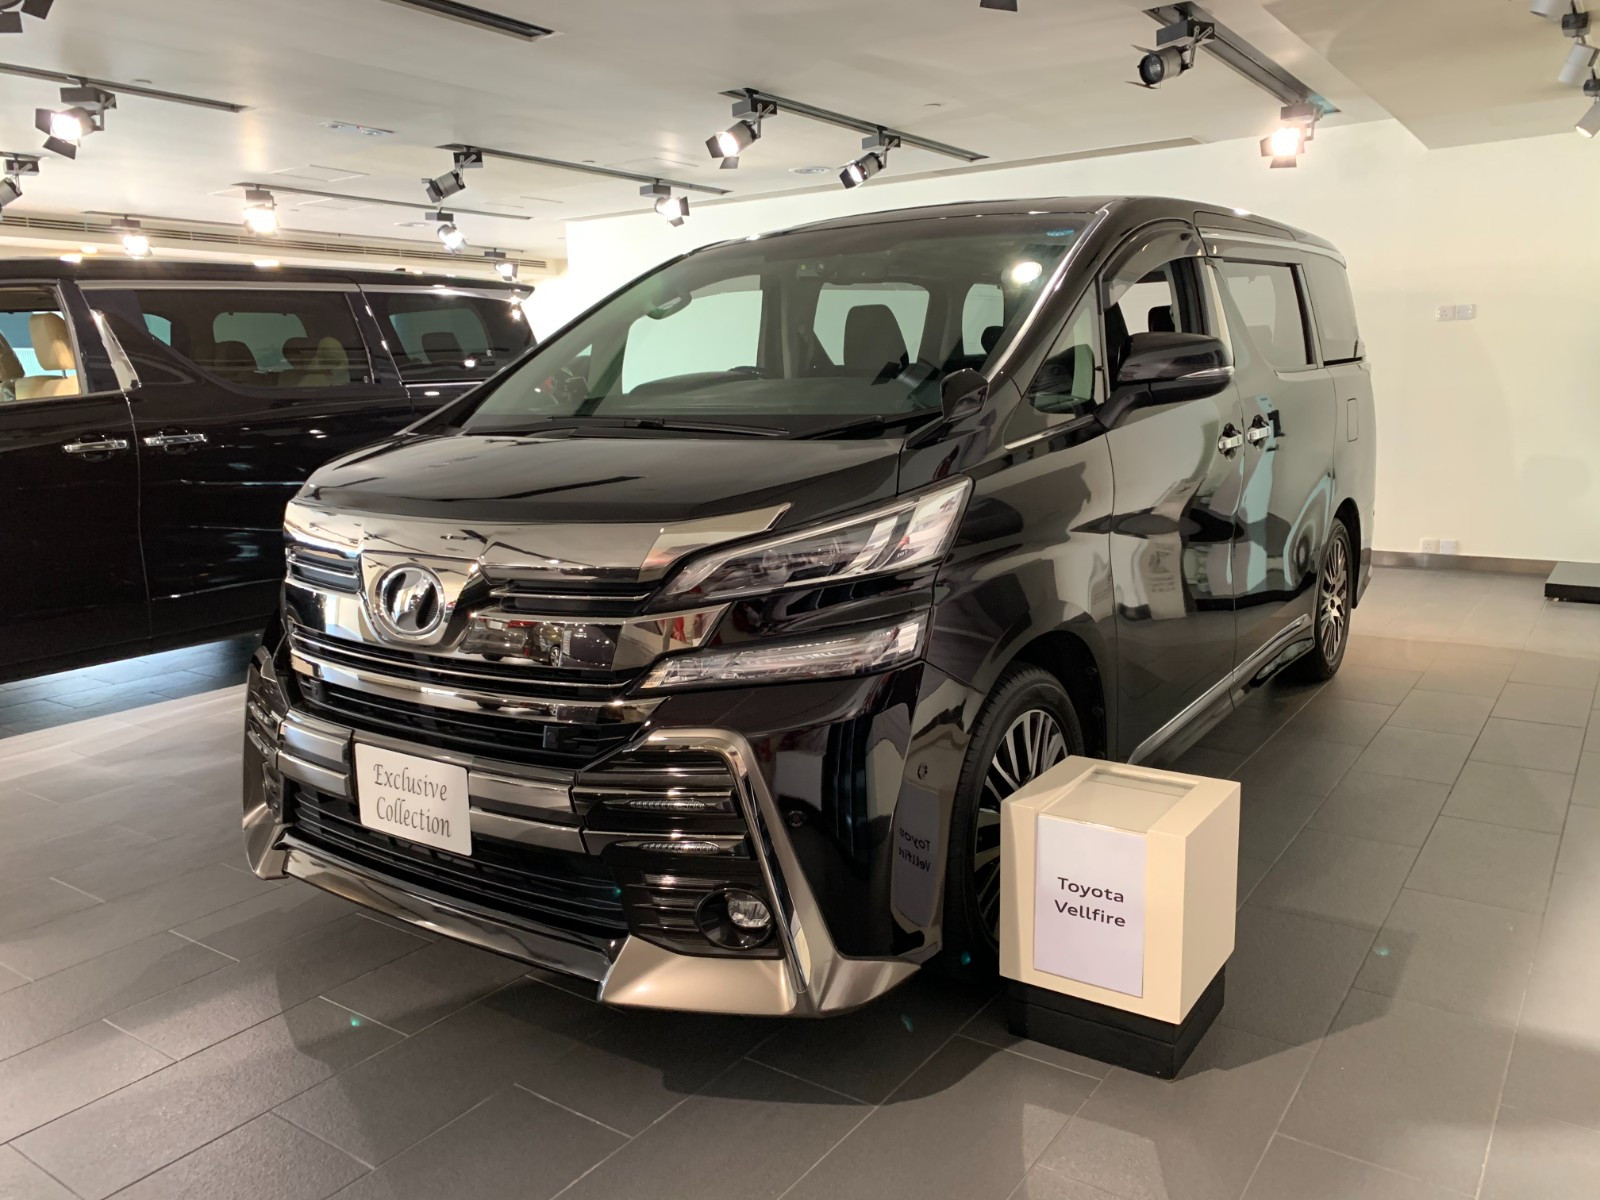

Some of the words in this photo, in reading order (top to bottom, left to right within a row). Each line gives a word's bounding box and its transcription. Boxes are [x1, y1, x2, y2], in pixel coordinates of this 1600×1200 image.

[373, 763, 447, 801] Exclusive
[376, 796, 450, 838] Collection
[1057, 876, 1124, 903] Toyota
[1054, 899, 1126, 927] Vellfire
